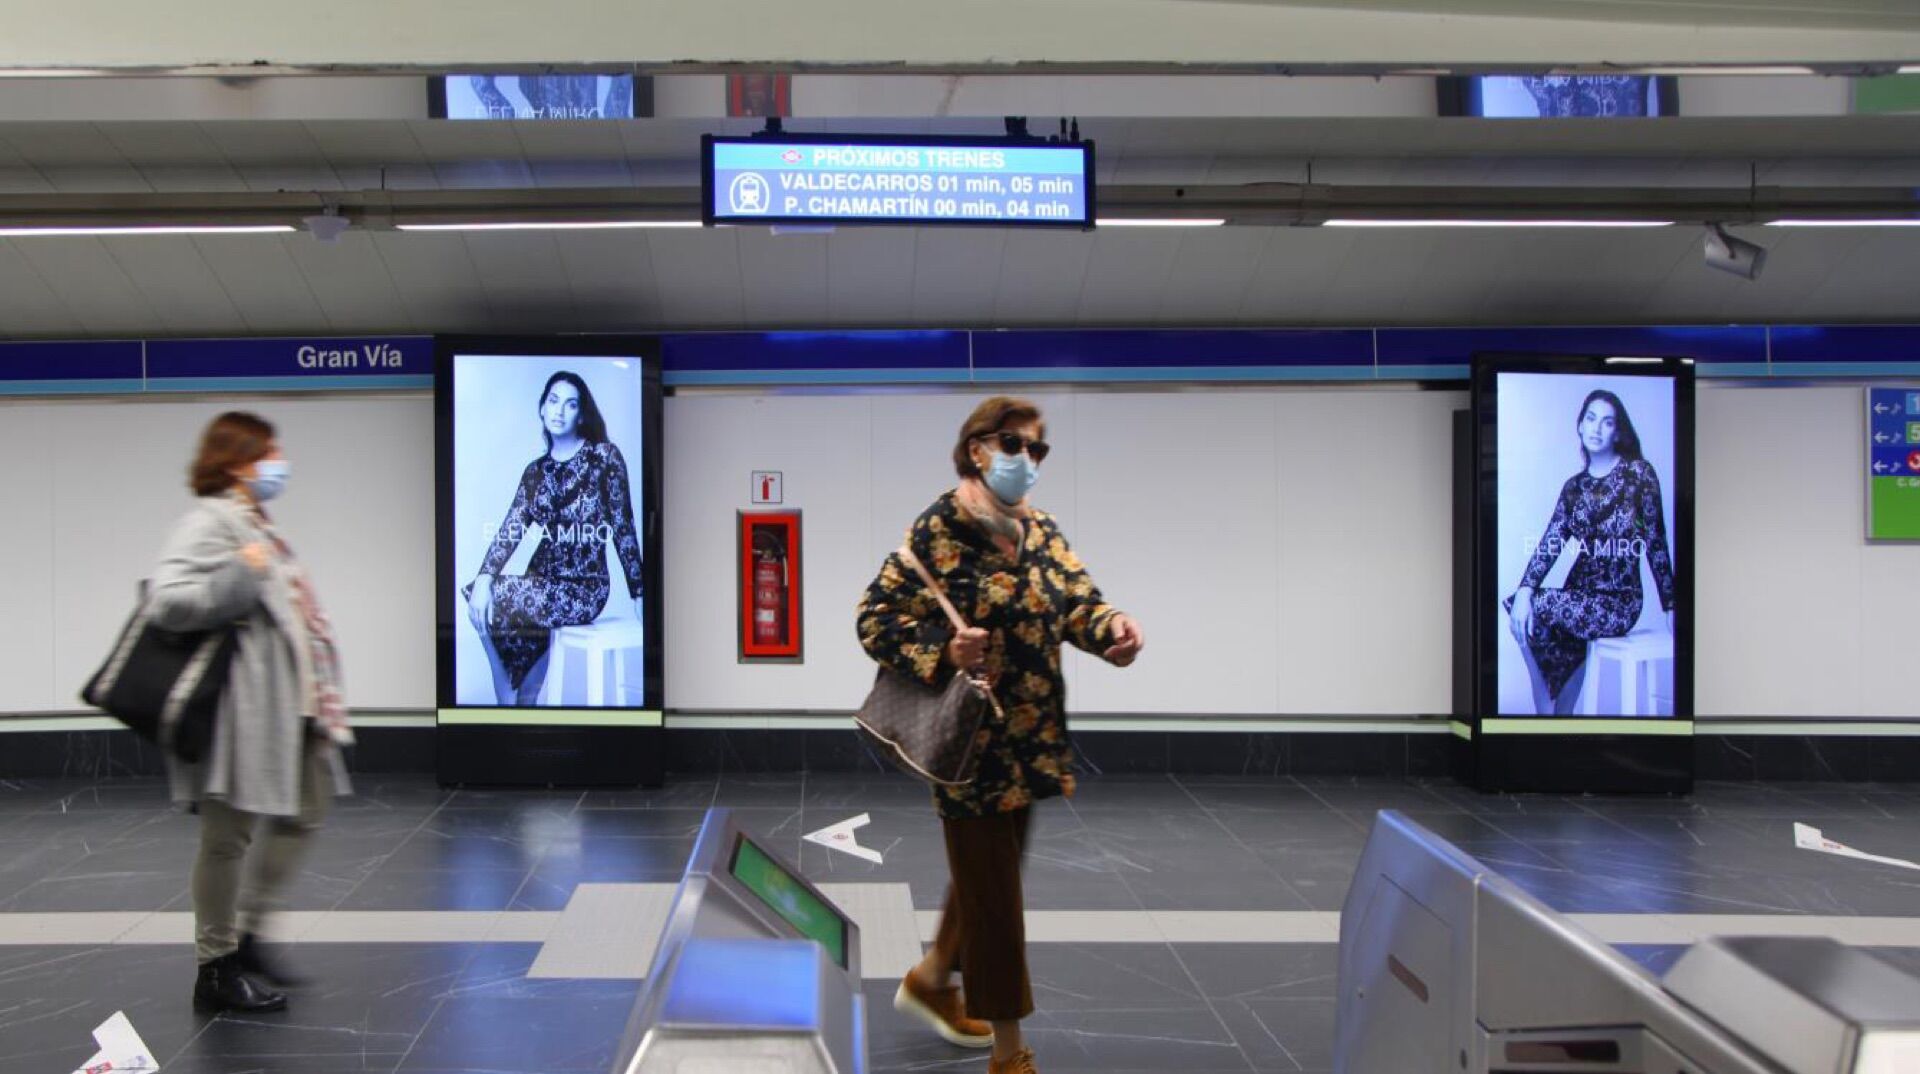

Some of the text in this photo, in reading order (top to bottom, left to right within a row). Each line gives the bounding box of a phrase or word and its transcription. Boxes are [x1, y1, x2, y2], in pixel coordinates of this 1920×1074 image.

[814, 146, 1005, 169] PRÓXIMOS TRENES
[780, 172, 1073, 195] VALDECARROS 01 min, 05 min
[784, 196, 803, 214] P.
[808, 194, 928, 216] CHAMARTÍN
[934, 199, 957, 216] 00
[1007, 200, 1029, 217] 04
[1035, 201, 1069, 218] min
[297, 344, 403, 368] Gran Vía
[482, 522, 553, 542] ELENA
[1524, 536, 1590, 557] ELENA
